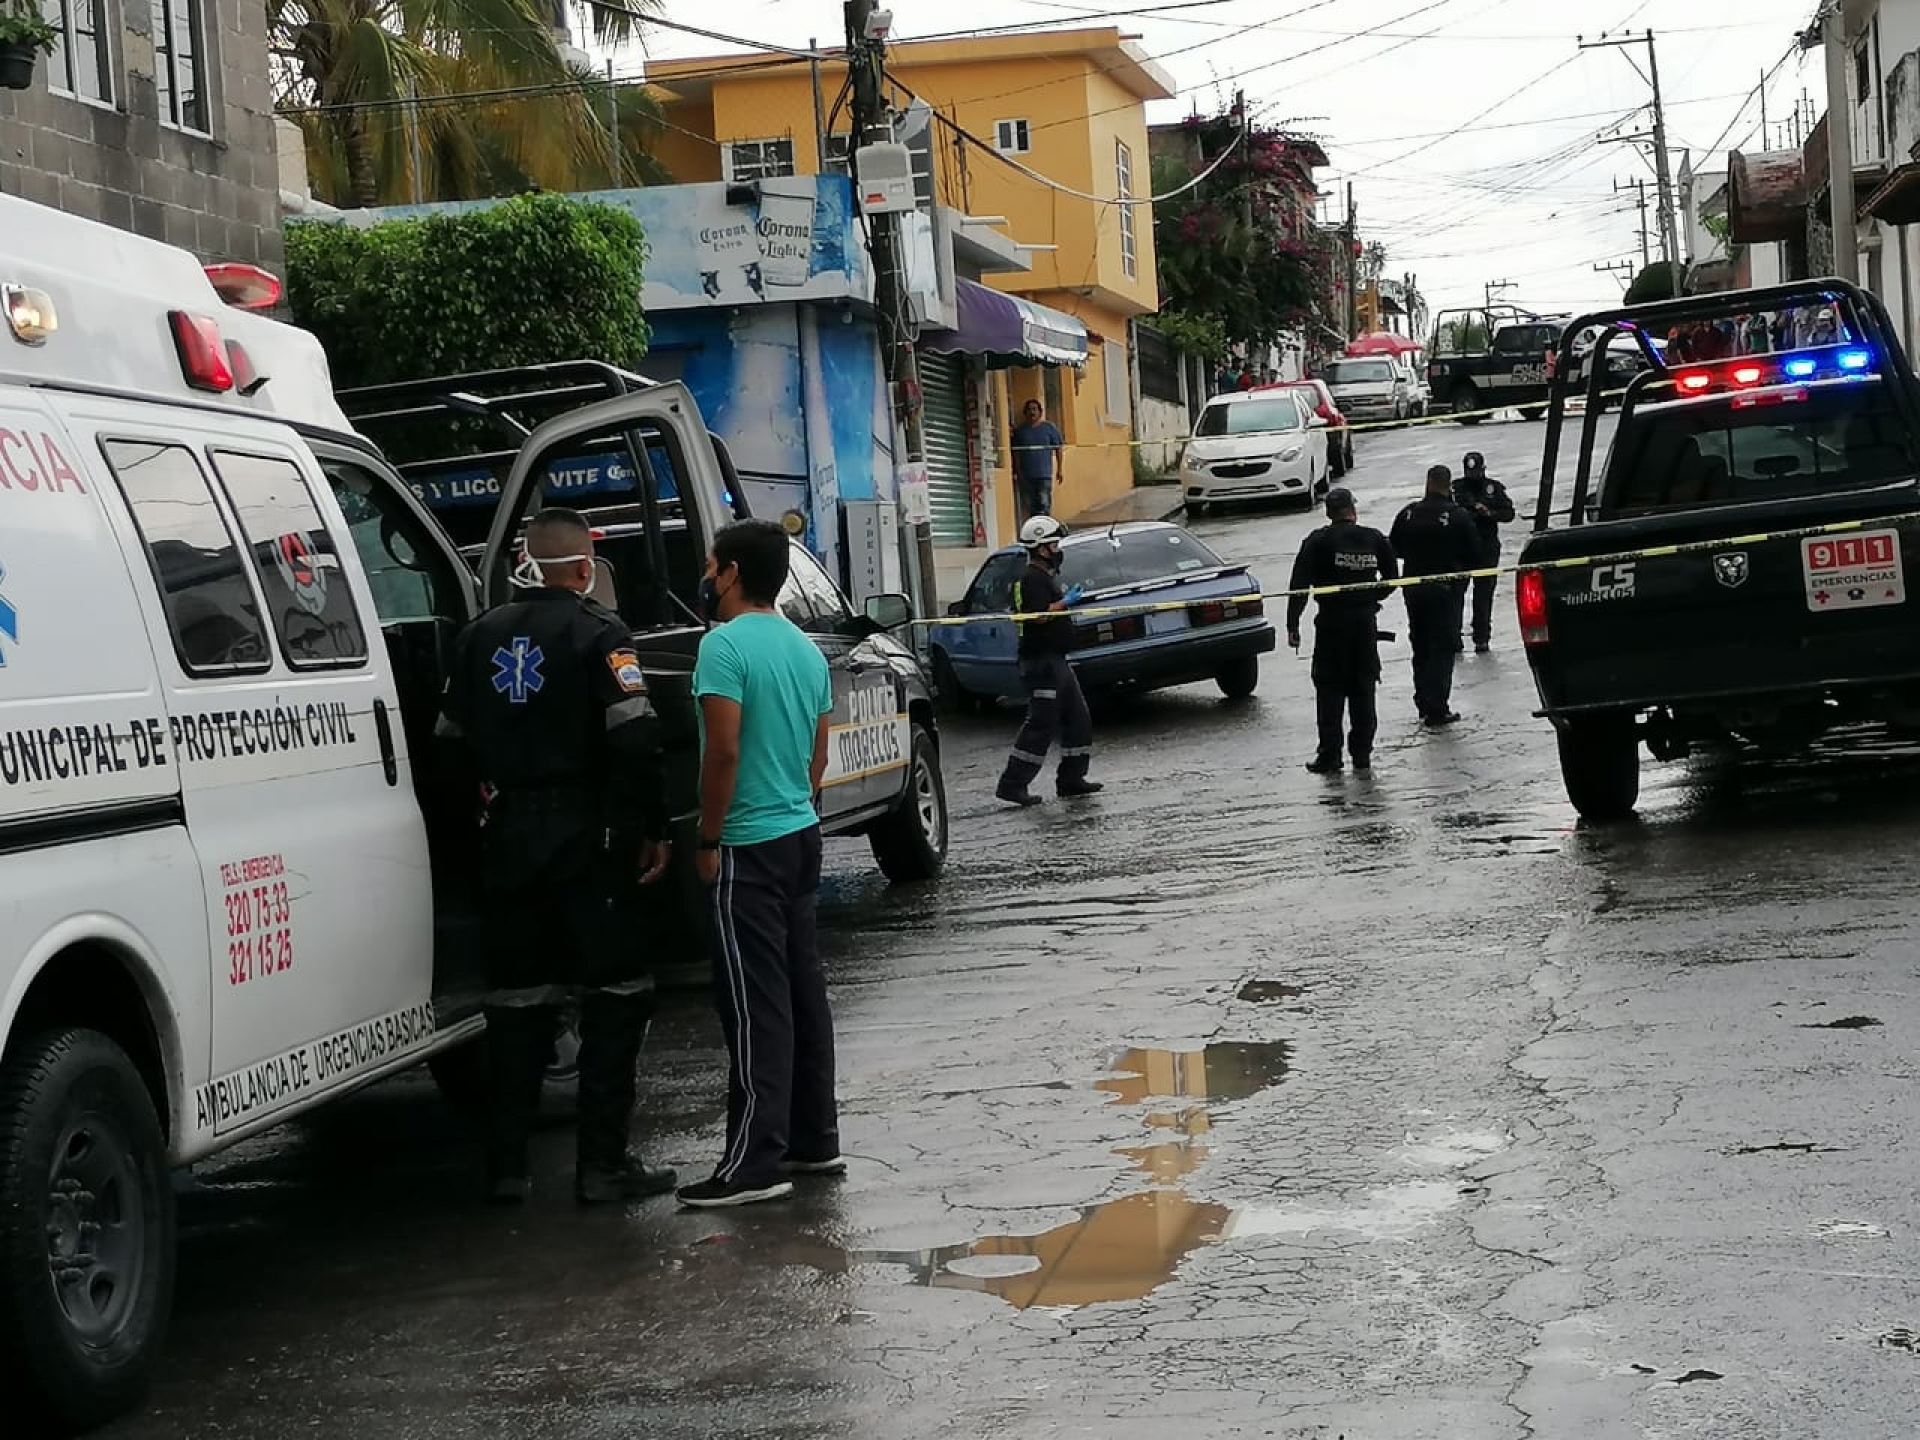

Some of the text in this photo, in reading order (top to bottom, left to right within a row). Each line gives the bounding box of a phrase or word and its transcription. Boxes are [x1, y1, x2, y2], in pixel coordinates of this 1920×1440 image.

[700, 224, 749, 244] Corona
[757, 216, 809, 240] Corona
[0, 427, 87, 494] CIA
[429, 482, 446, 499] Y
[1813, 539, 1886, 566] 911
[1811, 571, 1897, 588] EMERGENCIAS
[130, 718, 167, 769] DE
[168, 695, 305, 761] PROTECCIÓN
[305, 701, 357, 747] CIVIL
[839, 721, 900, 773] MORELOS
[225, 890, 251, 936] 320
[272, 881, 291, 925] 33
[229, 927, 293, 985] 321 15 25
[196, 1001, 435, 1130] AMBULANCIA DE URGENCIAS BASICAS
